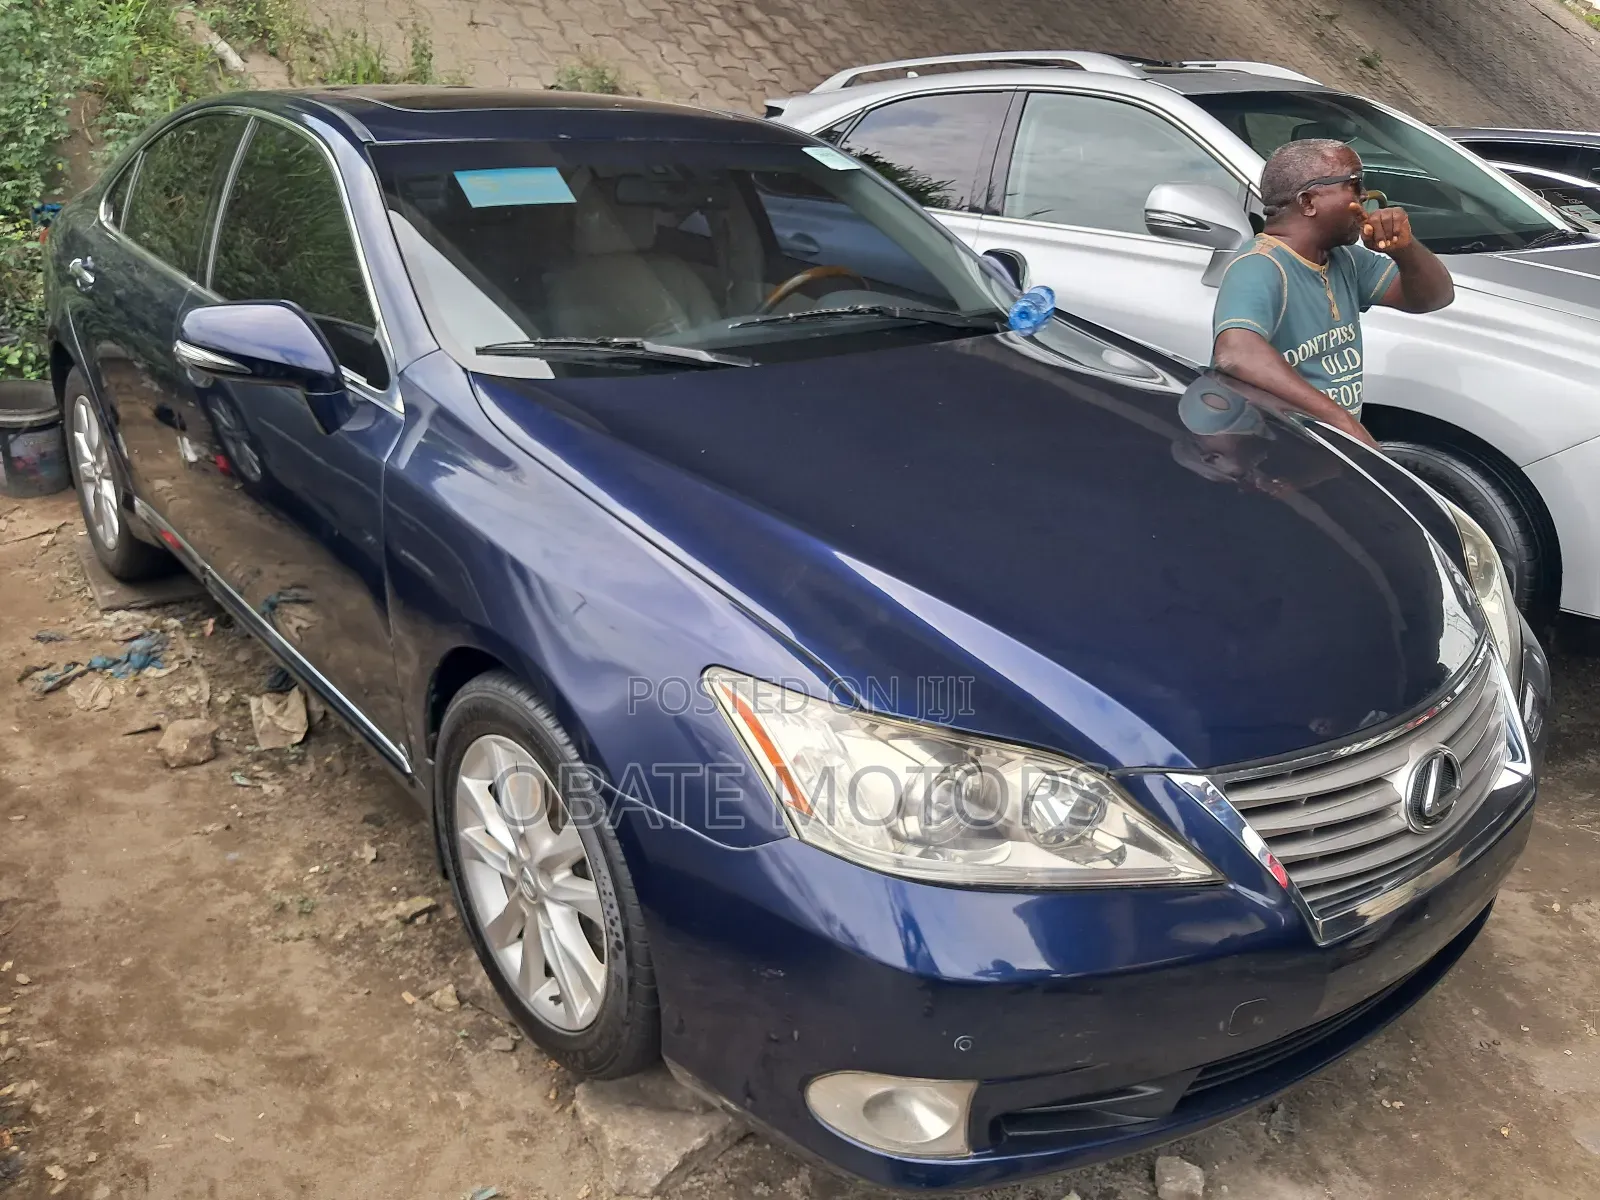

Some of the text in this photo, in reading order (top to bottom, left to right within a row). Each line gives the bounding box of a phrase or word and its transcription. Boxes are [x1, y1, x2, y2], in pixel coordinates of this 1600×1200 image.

[1283, 323, 1356, 367] DON'T PISS
[1321, 347, 1361, 375] OLD
[1319, 381, 1362, 407] EOP
